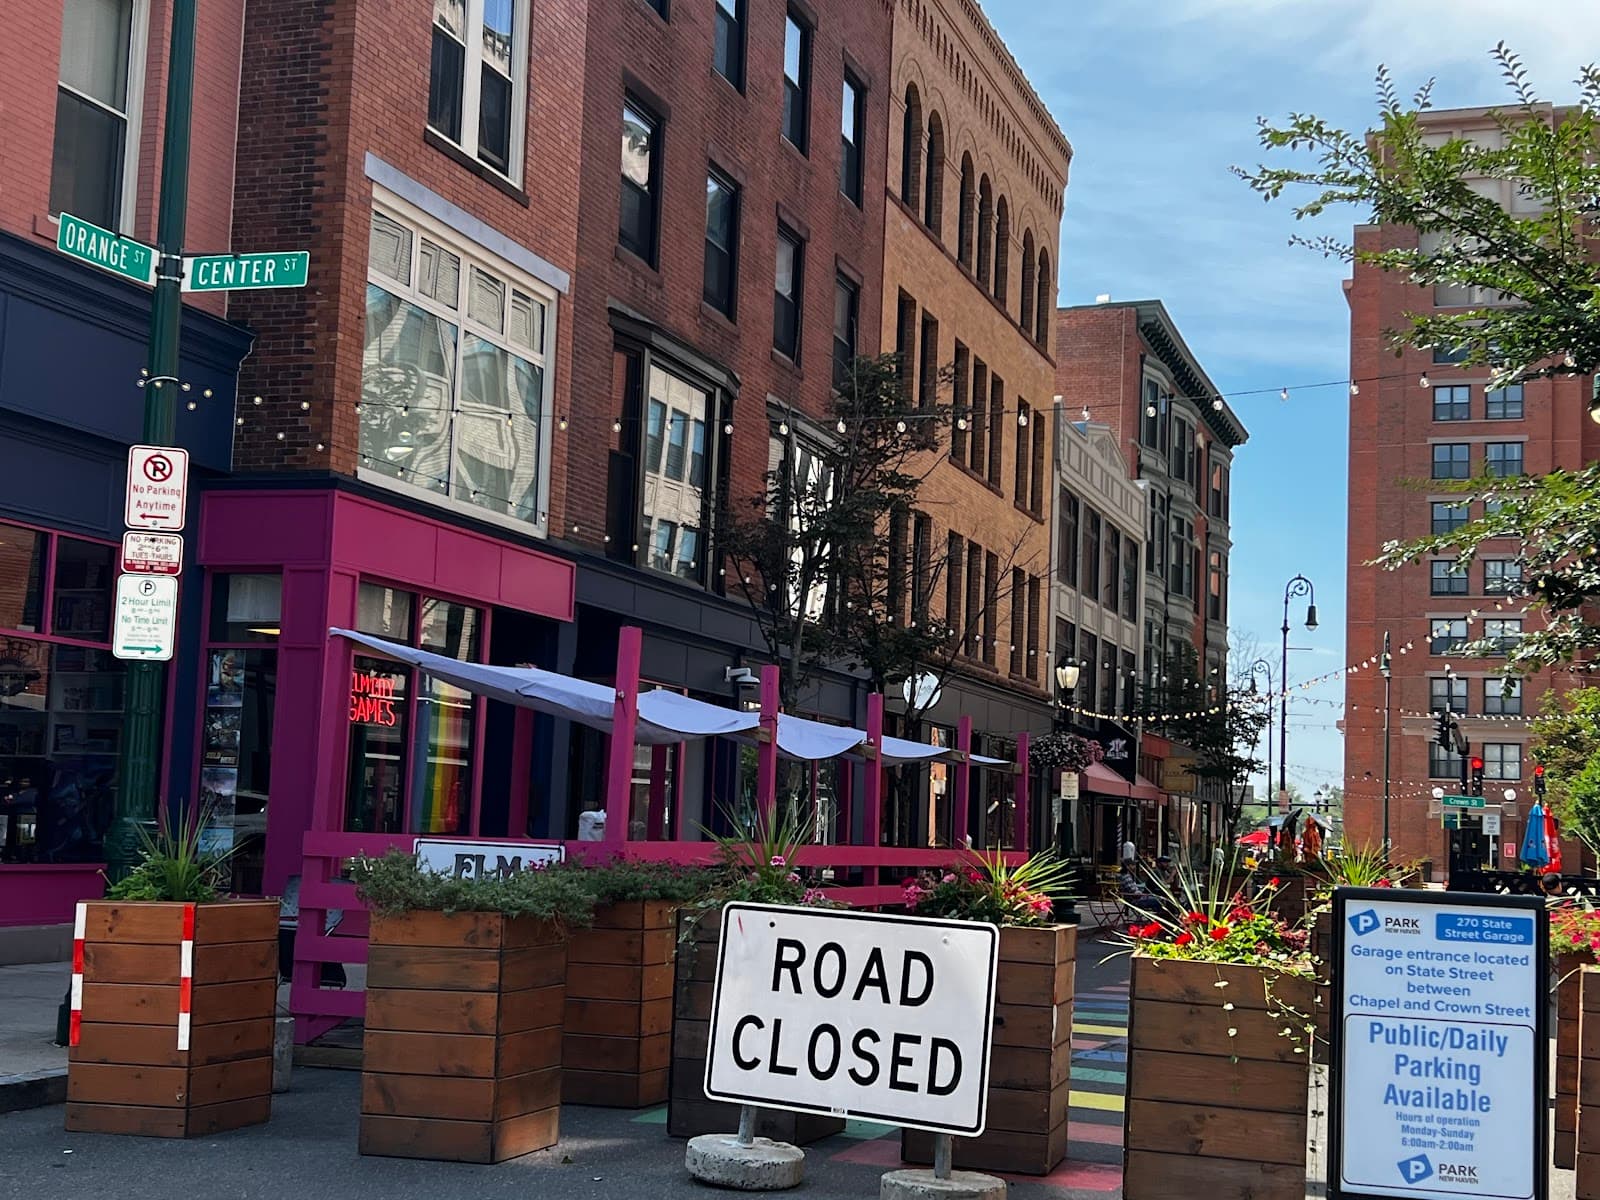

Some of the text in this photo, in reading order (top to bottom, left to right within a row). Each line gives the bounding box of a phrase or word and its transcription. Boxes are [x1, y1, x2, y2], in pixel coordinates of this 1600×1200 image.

[65, 222, 146, 270] ORANGE ST
[198, 258, 298, 286] CENTER ST
[132, 484, 182, 499] No Parking
[135, 500, 177, 512] Anytime
[130, 535, 141, 543] NO
[121, 596, 172, 607] 2 Hour Limit
[121, 615, 169, 625] No Time Limit
[351, 671, 370, 694] LM
[349, 695, 396, 727] GAMES
[1448, 797, 1478, 807] Crown St
[1384, 917, 1420, 929] PARK
[1456, 917, 1513, 930] 270 State
[1400, 928, 1421, 936] HAVEN
[1444, 928, 1525, 944] Street Garage
[1351, 944, 1529, 967] Garage entrance located
[772, 938, 934, 1007] ROAD
[1385, 964, 1494, 982] on State Street
[1407, 981, 1471, 997] between
[1350, 994, 1531, 1018] Chapel and Crown Street
[1369, 1021, 1509, 1058] Public/Daily
[732, 1014, 962, 1096] CLOSED
[1394, 1053, 1482, 1086] Parking
[1383, 1083, 1492, 1113] Available
[1395, 1111, 1481, 1128] Hours of operation
[1401, 1124, 1475, 1141] Monday-Sunday
[1401, 1136, 1474, 1152] 6:00am-2:00am
[1438, 1163, 1478, 1177] PARK
[1438, 1175, 1479, 1185] NEW HAVEN
